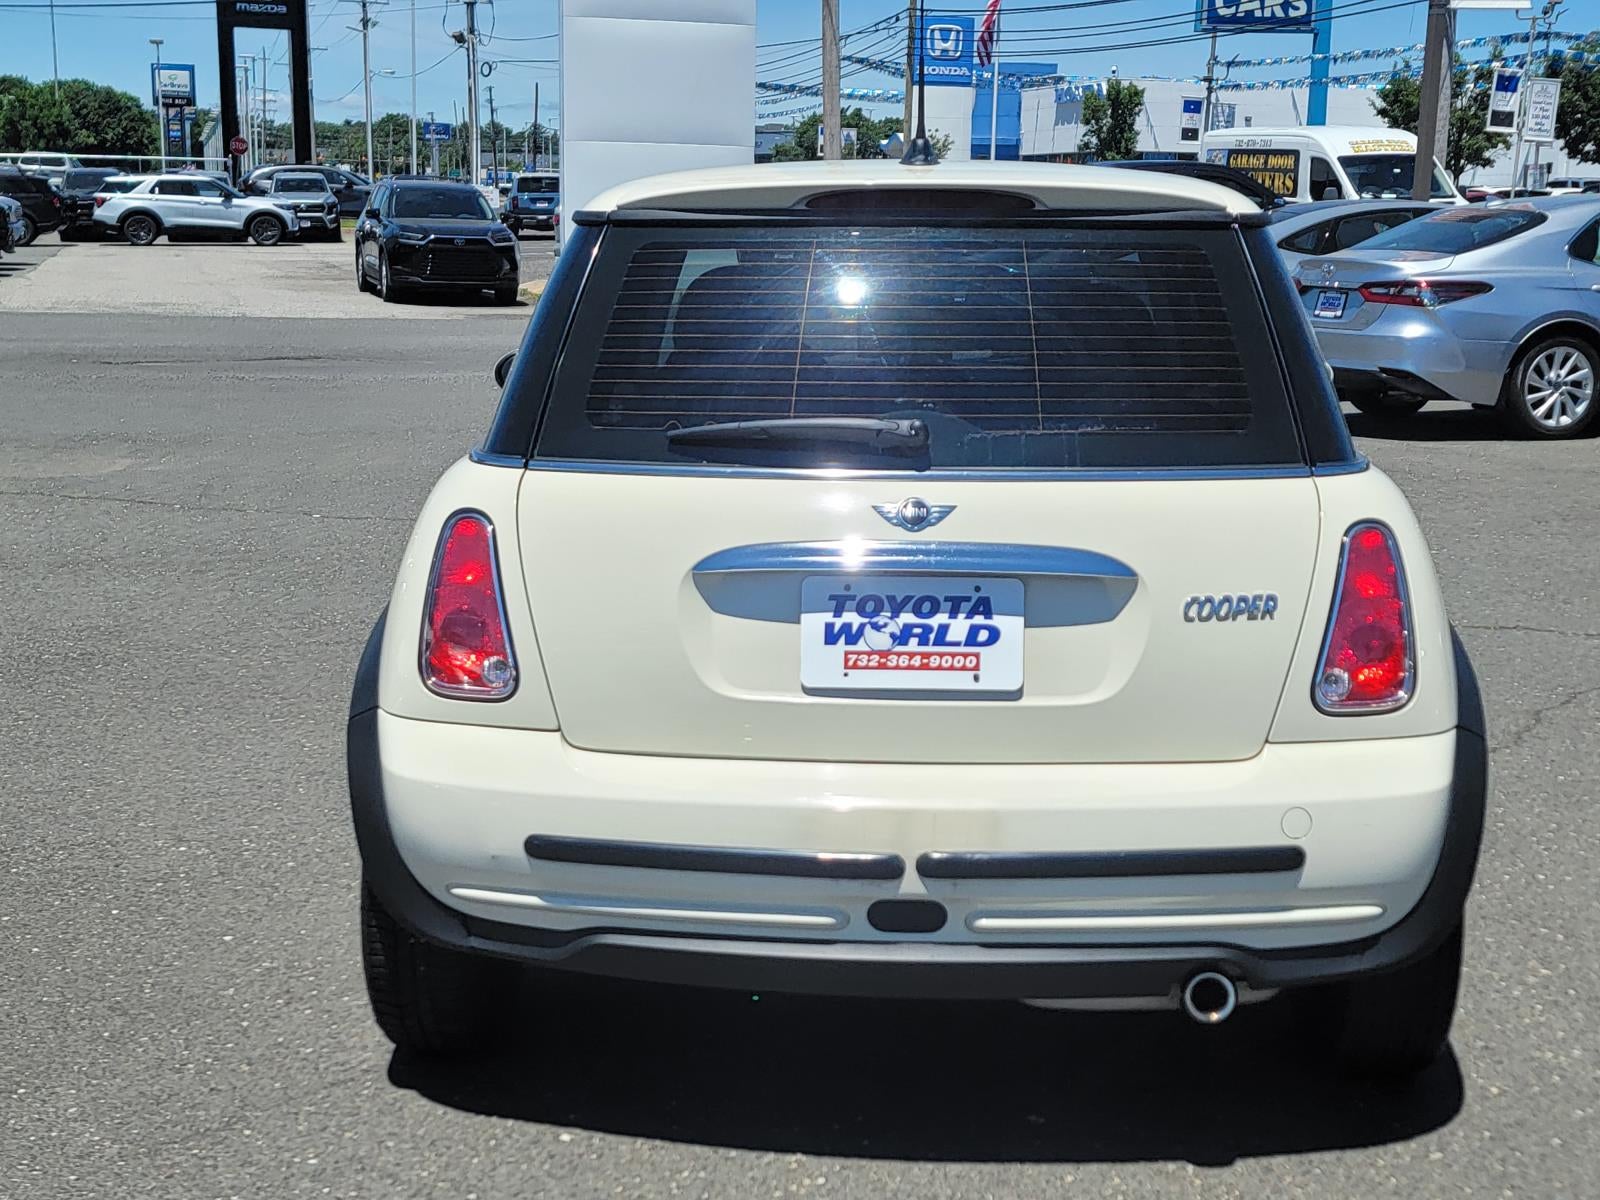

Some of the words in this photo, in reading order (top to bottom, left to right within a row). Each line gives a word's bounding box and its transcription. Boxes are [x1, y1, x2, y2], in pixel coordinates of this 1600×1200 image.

[916, 65, 972, 76] HONDA
[231, 141, 248, 150] STOP
[1229, 153, 1266, 169] GARAGE
[1267, 154, 1296, 169] DOOR
[828, 594, 994, 620] TOYOTA
[1184, 594, 1278, 622] COOPER
[846, 653, 978, 669] 732-364-9000
